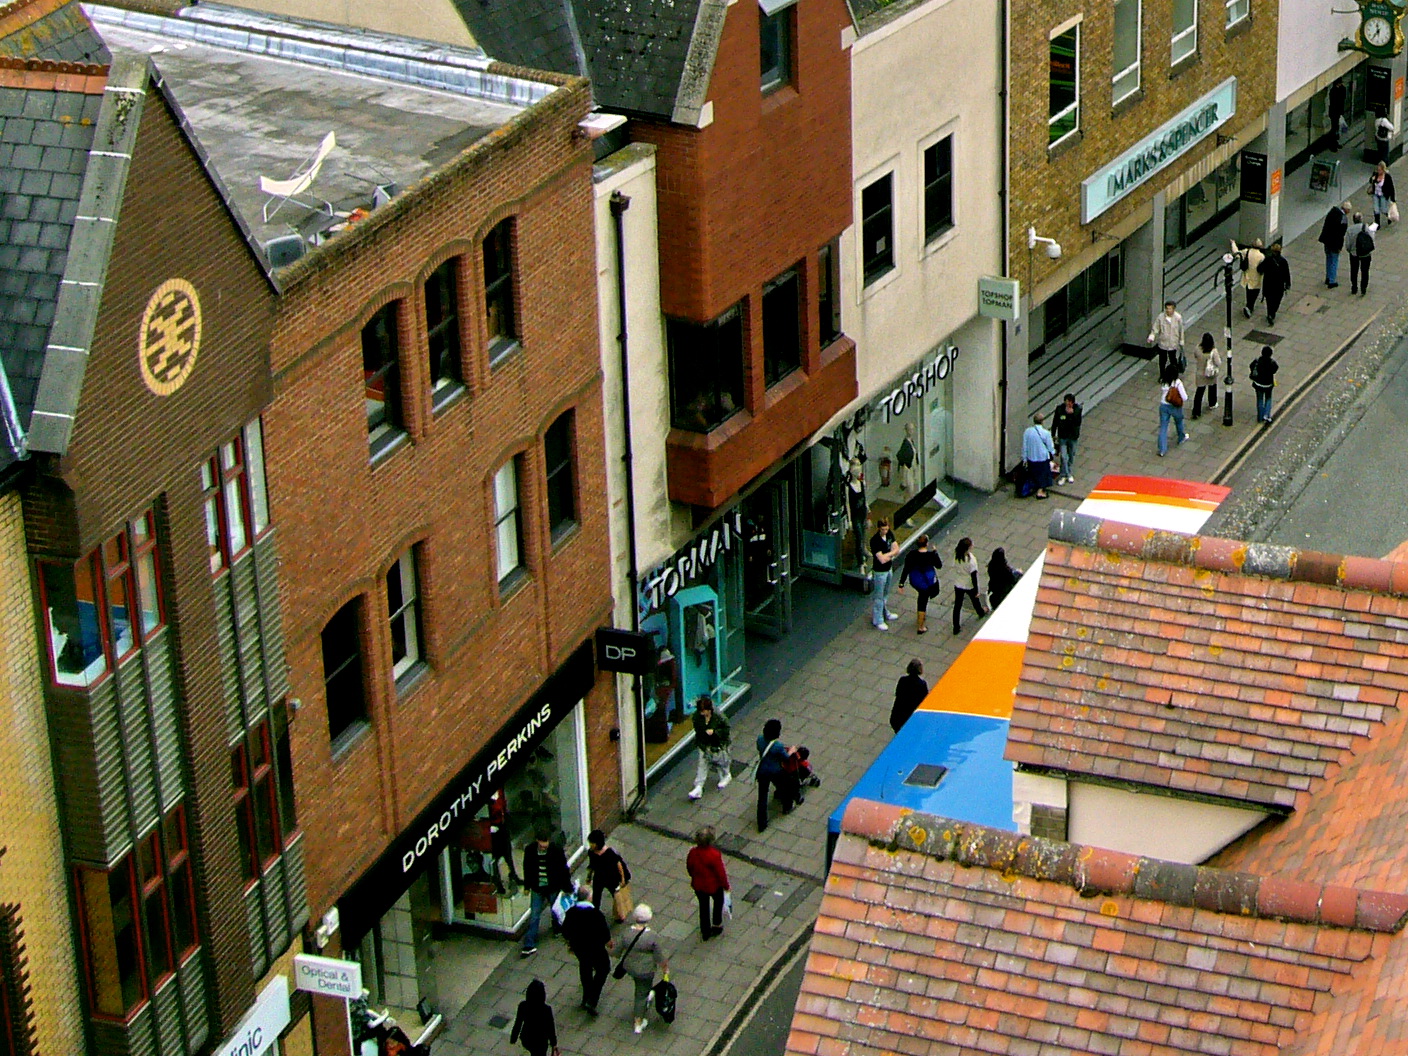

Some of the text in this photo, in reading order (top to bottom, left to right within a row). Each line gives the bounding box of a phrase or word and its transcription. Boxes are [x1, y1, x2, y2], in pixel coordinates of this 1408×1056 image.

[981, 289, 1013, 301] TOPSHOP
[982, 297, 1013, 310] TOPMAN
[878, 346, 959, 424] TOPSHOP
[605, 645, 637, 661] DP
[402, 702, 552, 874] DOROTHY PERKINS
[301, 964, 349, 982] Optical &
[318, 977, 351, 993] Dental
